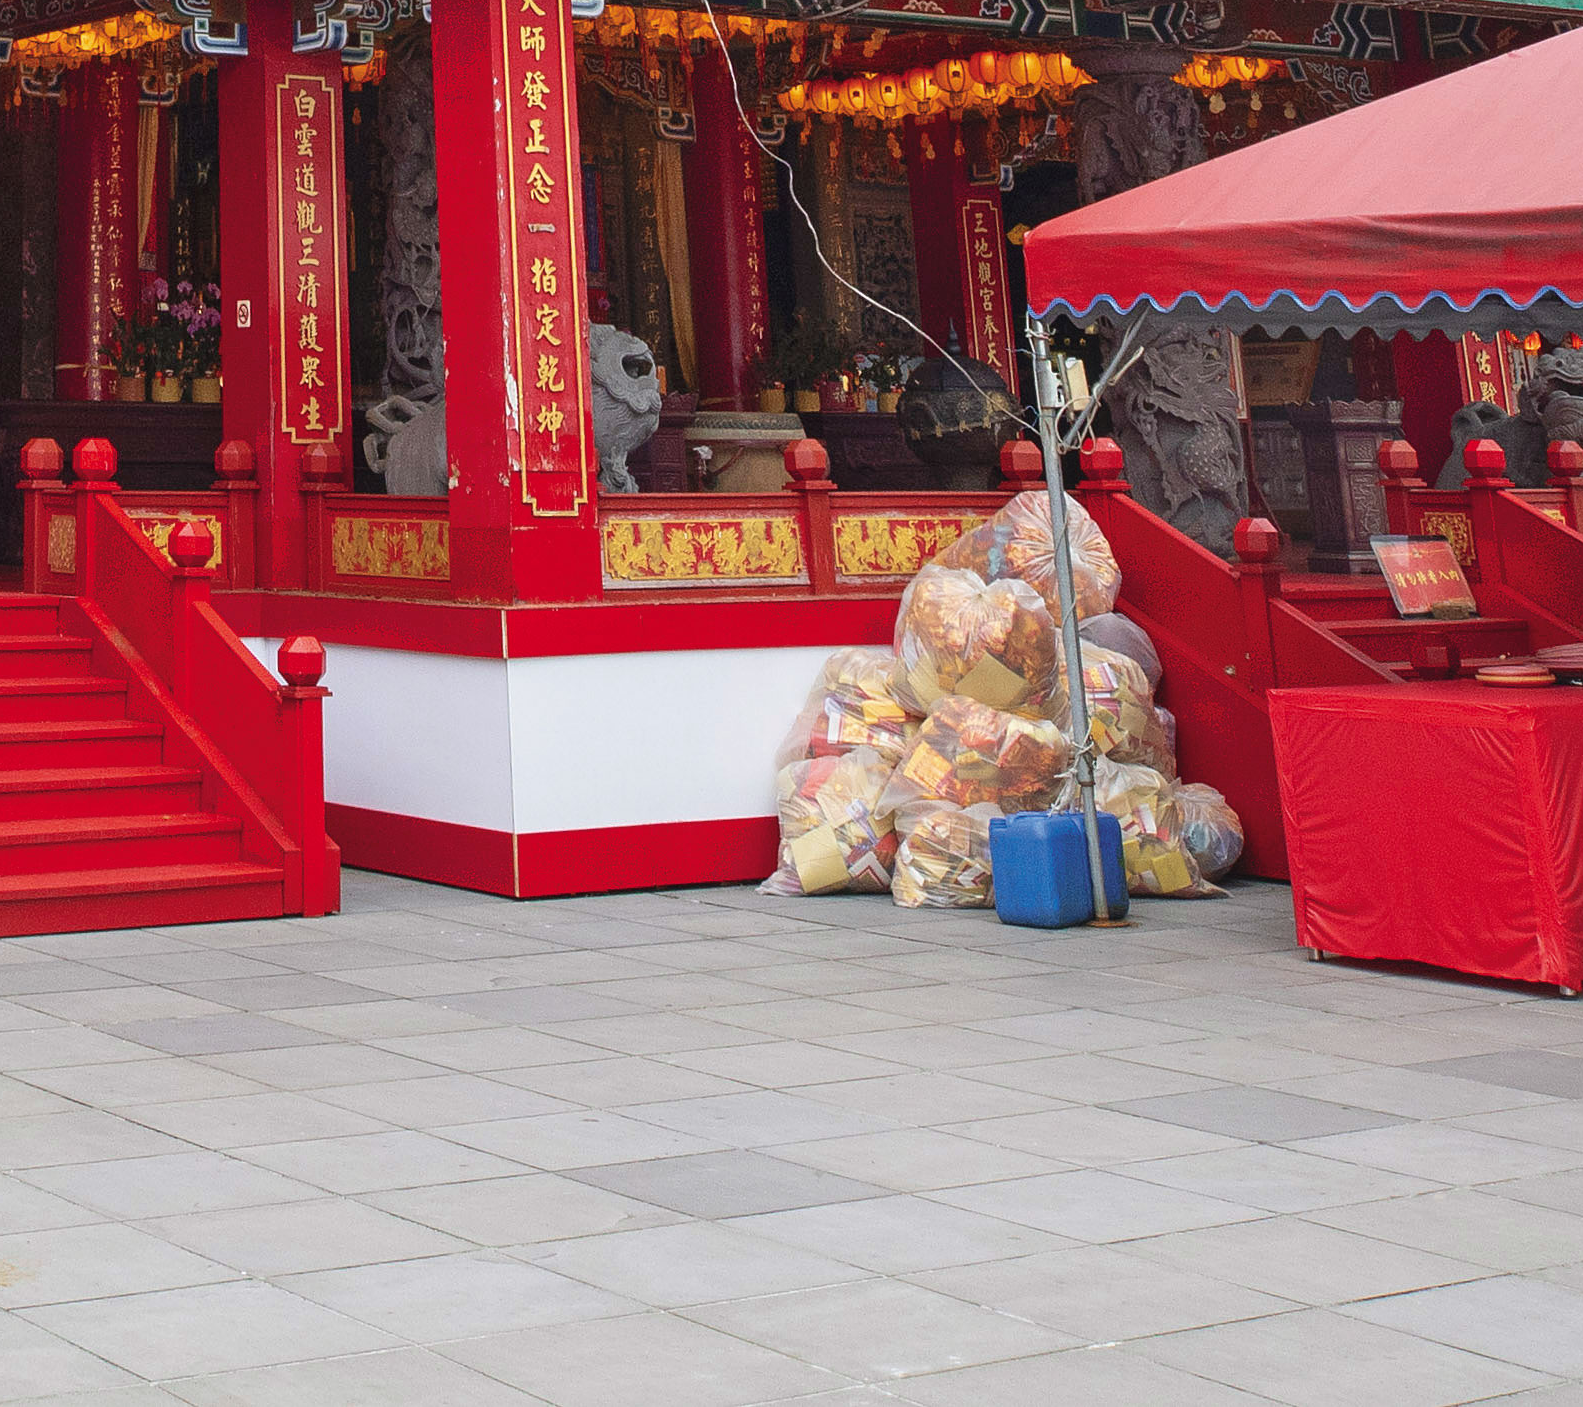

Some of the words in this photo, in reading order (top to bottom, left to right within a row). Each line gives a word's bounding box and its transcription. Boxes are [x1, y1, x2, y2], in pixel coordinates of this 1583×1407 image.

[974, 213, 1002, 373] 三地觀宮奉天
